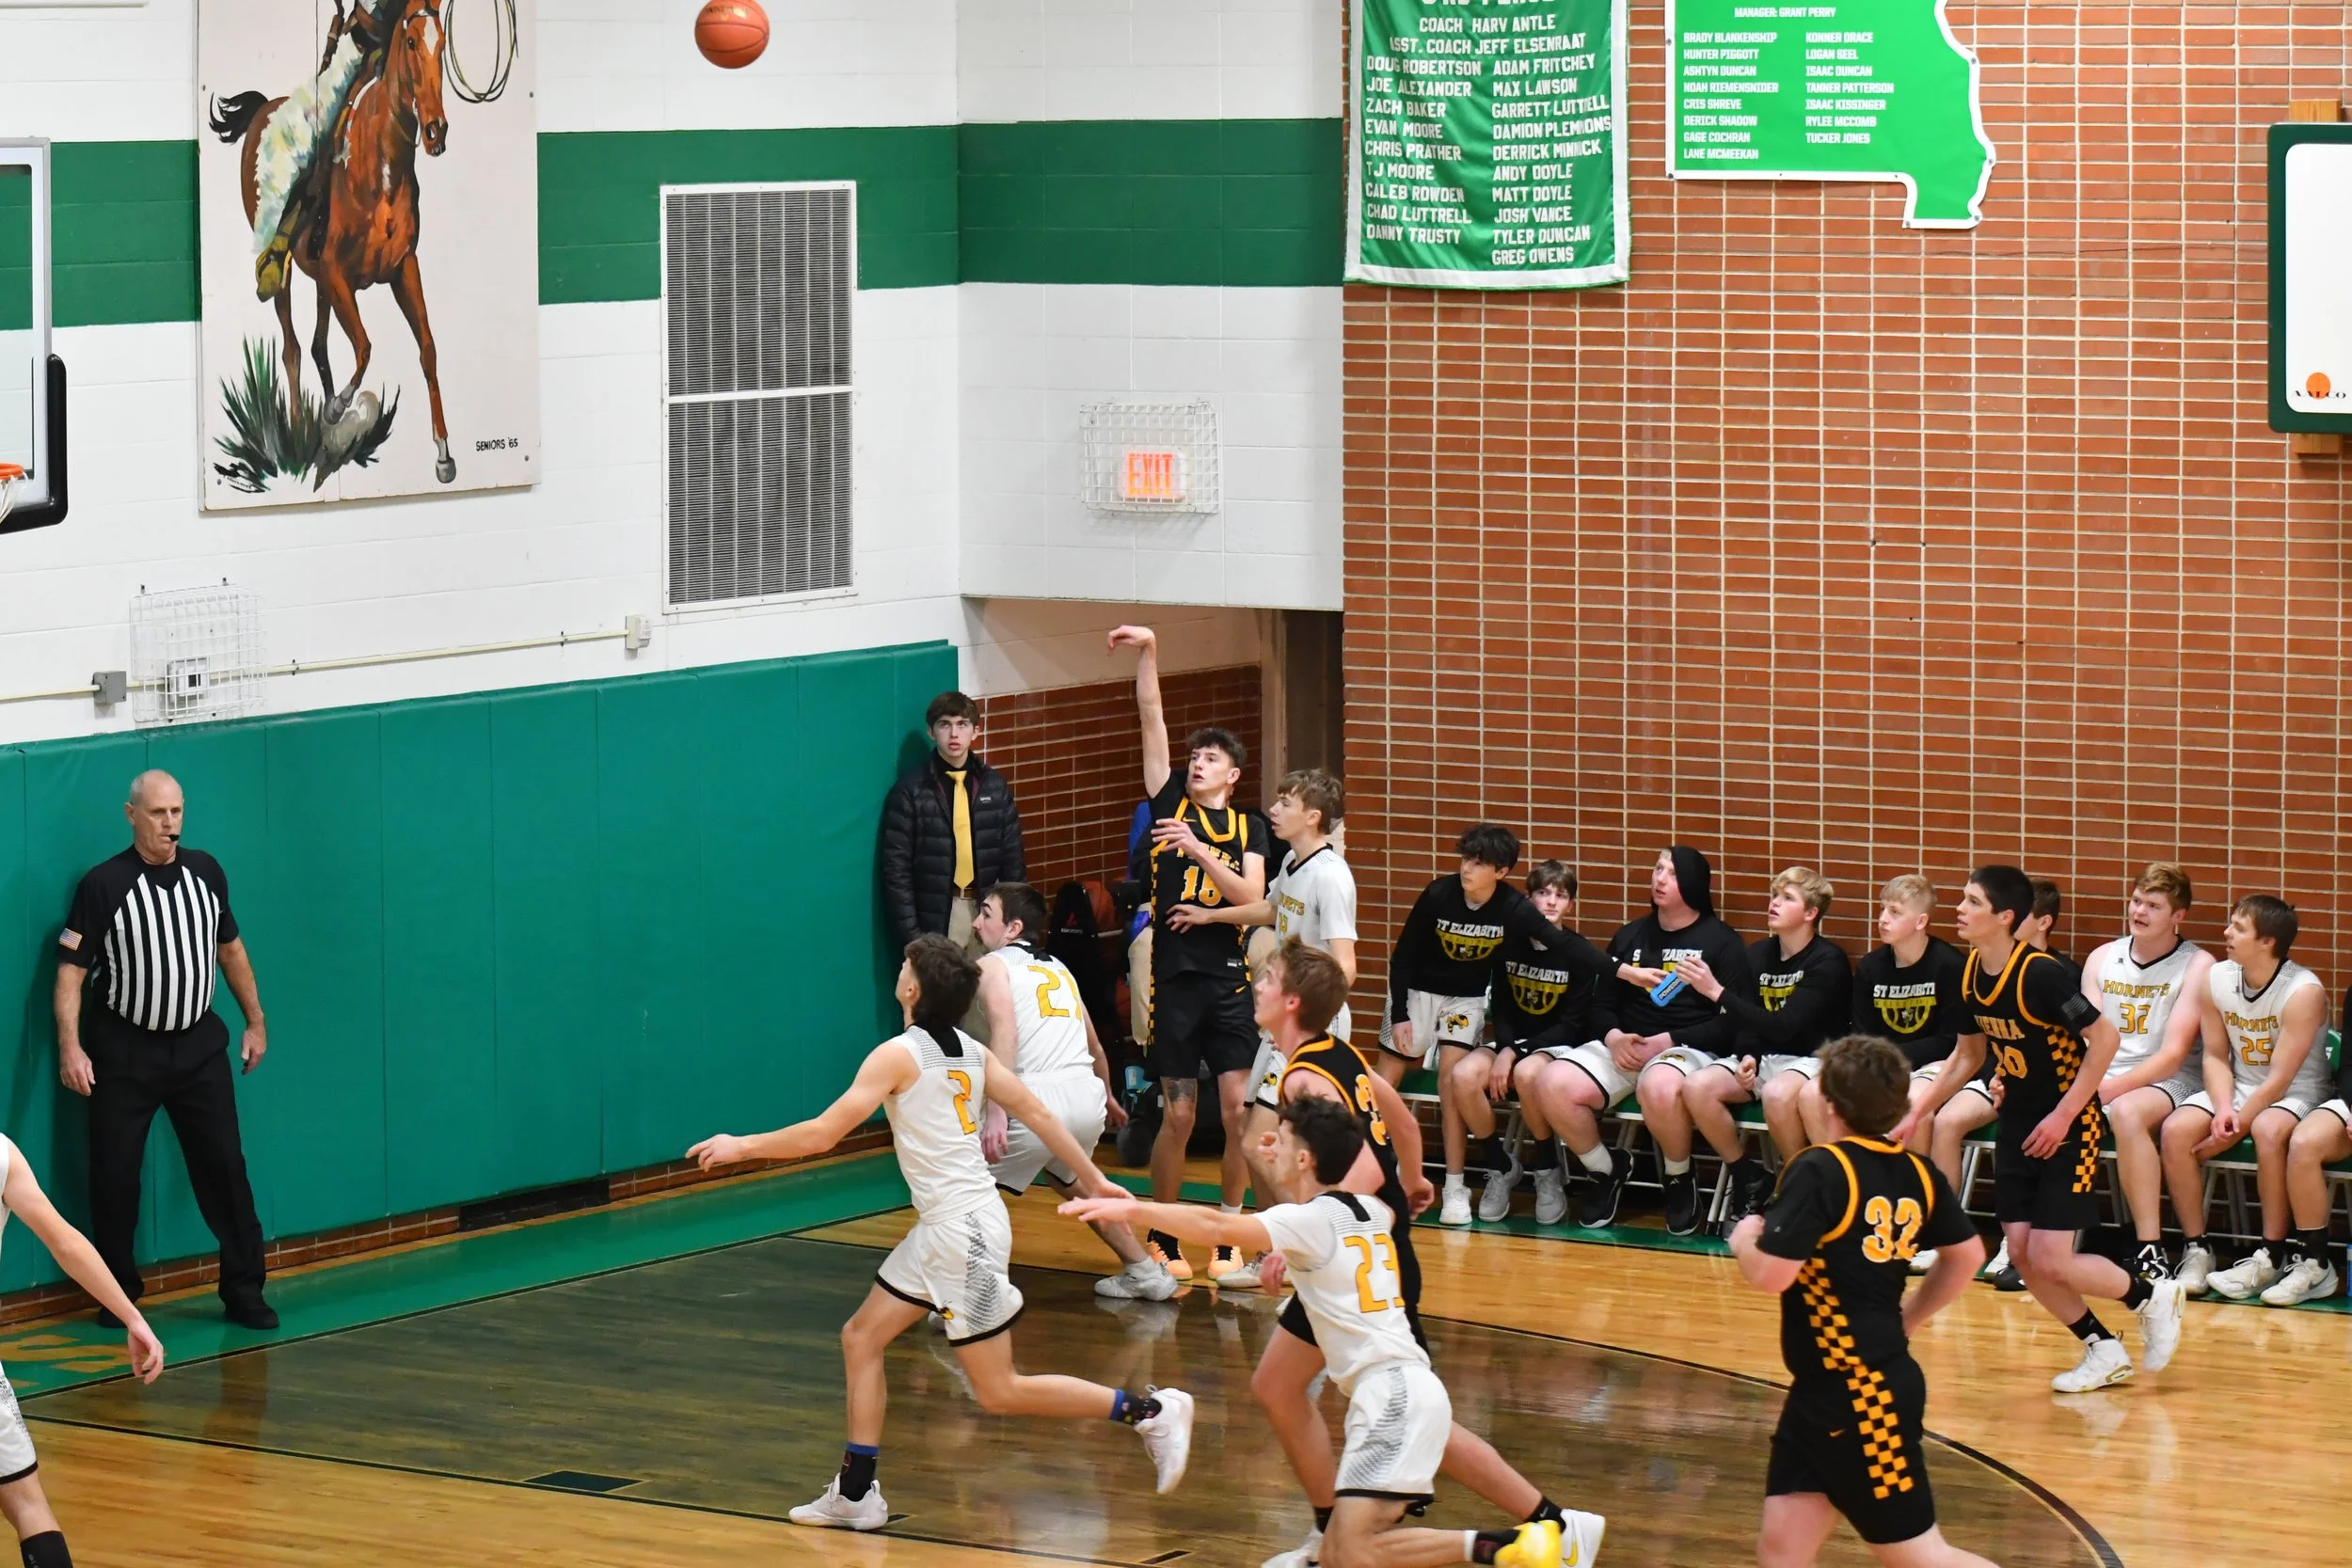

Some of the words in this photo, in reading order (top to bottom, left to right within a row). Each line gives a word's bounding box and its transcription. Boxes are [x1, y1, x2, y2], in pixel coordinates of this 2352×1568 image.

[1734, 7, 1778, 17] MANAGER:
[1779, 7, 1807, 17] GRANT
[1808, 7, 1836, 17] PERRY
[1420, 17, 1463, 33] COACH
[1472, 17, 1508, 33] HARV
[1512, 13, 1556, 32] ANTLE
[1426, 39, 1471, 55] COACH
[1474, 39, 1509, 55] JEFF
[1513, 32, 1586, 54] ELSENRAAT
[1684, 32, 1712, 43] BRADY
[1714, 32, 1778, 43] BLANKENSHIP
[1805, 32, 1842, 43] KONNER
[1684, 49, 1719, 60] HUNTER
[1720, 49, 1759, 60] PIGGOTT
[1805, 49, 1836, 60] LOGAN
[1836, 49, 1859, 60] SEEL
[1366, 55, 1400, 72] DOUG
[1403, 59, 1481, 75] ROBERTSON
[1493, 59, 1530, 75] ADAM
[1534, 53, 1596, 73] FRITCHEY
[1683, 66, 1719, 76] ASHTYN
[1720, 66, 1757, 76] DUNCAN
[1805, 66, 1835, 77] ISAAC
[1835, 66, 1872, 77] DUNCAN
[1366, 77, 1392, 92] JOE
[1398, 79, 1471, 97] ALEXANDER
[1493, 81, 1520, 96] MAX
[1526, 77, 1578, 96] LAWSON
[1684, 82, 1708, 92] NOAH
[1805, 83, 1841, 93] TANNER
[1842, 83, 1895, 93] PATTERSON
[1366, 98, 1402, 115] ZACH
[1406, 102, 1446, 118] BAKER
[1492, 102, 1550, 119] GARRETT
[1684, 98, 1707, 109] CRIS
[1707, 98, 1742, 109] SHREVE
[1805, 100, 1835, 110] ISAAC
[1835, 100, 1886, 110] KISSINGER
[1365, 119, 1397, 135] EVAN
[1402, 122, 1443, 139] MOORE
[1684, 115, 1718, 126] DERICK
[1718, 115, 1757, 126] SHADOW
[1805, 116, 1833, 127] RYLEE
[1835, 116, 1877, 127] MCCOMB
[1493, 122, 1543, 139] DAMION
[1684, 132, 1707, 143] GAGE
[1708, 132, 1751, 143] COCHRAN
[1805, 132, 1841, 144] TUCKER
[1842, 132, 1870, 144] JONES
[1365, 140, 1402, 157] CHRIS
[1406, 143, 1462, 161] PRATHER
[1493, 144, 1549, 161] DERRICK
[1684, 149, 1707, 159] LANE
[1707, 149, 1759, 159] MCMEEKAN
[1387, 164, 1435, 181] MOORE
[1493, 166, 1528, 181] ANDY
[1532, 164, 1573, 180] DOYLE
[1365, 182, 1407, 199] CALEB
[1412, 186, 1465, 202] ROWDEN
[1492, 187, 1529, 202] MATT
[1533, 184, 1573, 201] DOYLE
[1367, 203, 1397, 220] CHAD
[1402, 206, 1471, 224] LUTTRELL
[1494, 208, 1530, 224] JOSH
[1532, 206, 1573, 222] VANCE
[1366, 224, 1404, 241] DANNY
[1408, 228, 1460, 245] TRUSTY
[1493, 229, 1534, 245] TYLER
[1538, 225, 1591, 244] DUNCAN
[1492, 249, 1526, 265] GREG
[1530, 246, 1574, 263] OWENS
[476, 438, 506, 451] SENIORS
[508, 436, 518, 449] '65
[1128, 452, 1174, 496] EXIT
[1873, 984, 1887, 998] ST
[2103, 980, 2170, 998] HORNETS
[2119, 1003, 2151, 1034] 32
[2239, 1036, 2273, 1066] 25
[947, 1069, 977, 1135] 2
[1861, 1196, 1923, 1263] 32
[1343, 1233, 1406, 1313] 23
